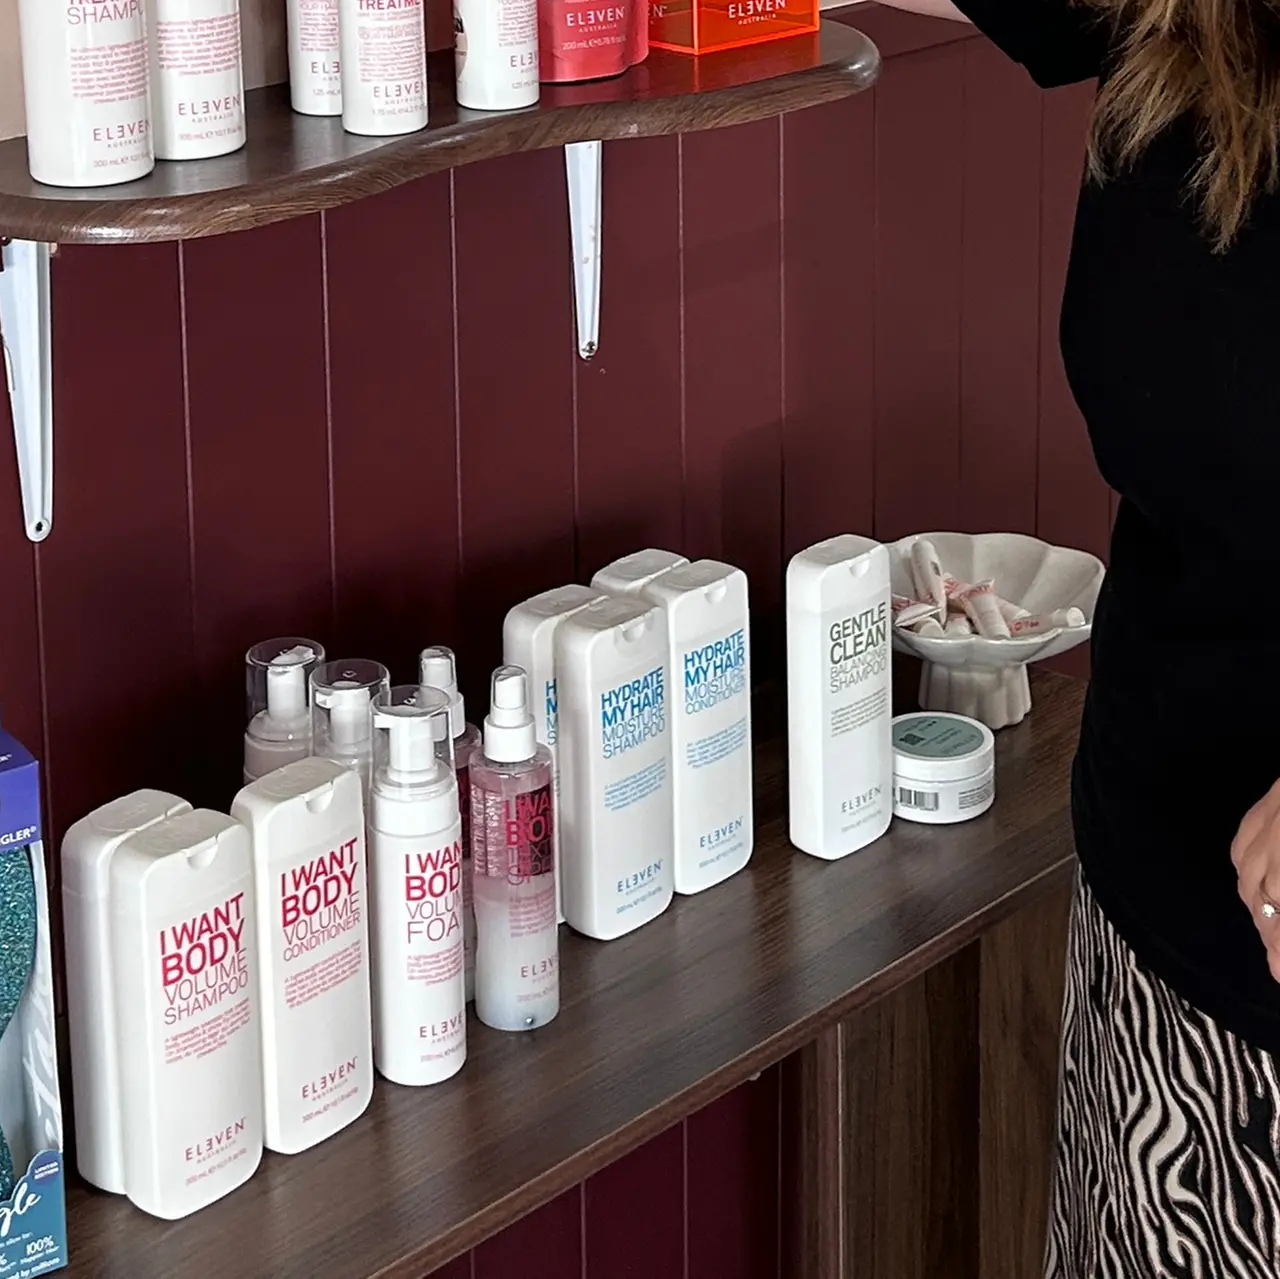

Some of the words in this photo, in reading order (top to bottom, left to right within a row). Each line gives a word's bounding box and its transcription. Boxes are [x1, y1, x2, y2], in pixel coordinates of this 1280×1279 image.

[830, 601, 886, 642] GENTLE
[830, 621, 886, 665] CLEAN
[683, 628, 745, 669] HYDRATE
[685, 662, 711, 688] MY
[713, 646, 745, 678] HAIR
[601, 666, 664, 710] HYDRATE
[601, 701, 628, 728] MY
[630, 684, 665, 720] HAIR
[602, 705, 665, 744] MOISTURE
[602, 721, 666, 760] SHAMPOO
[281, 872, 287, 898] I
[291, 837, 358, 892] WANT
[404, 853, 410, 874] I
[405, 862, 462, 902] BOD
[281, 861, 359, 929] BODY
[160, 930, 166, 956] I
[171, 891, 245, 950] WANT
[283, 890, 361, 946] VOLUME
[283, 912, 361, 963] CONDITIONER
[407, 911, 462, 945] FOA
[161, 917, 246, 988] BODY
[164, 947, 248, 1006] VOLUME
[164, 970, 249, 1026] SHAMPOO
[26, 1235, 55, 1255] 100%
